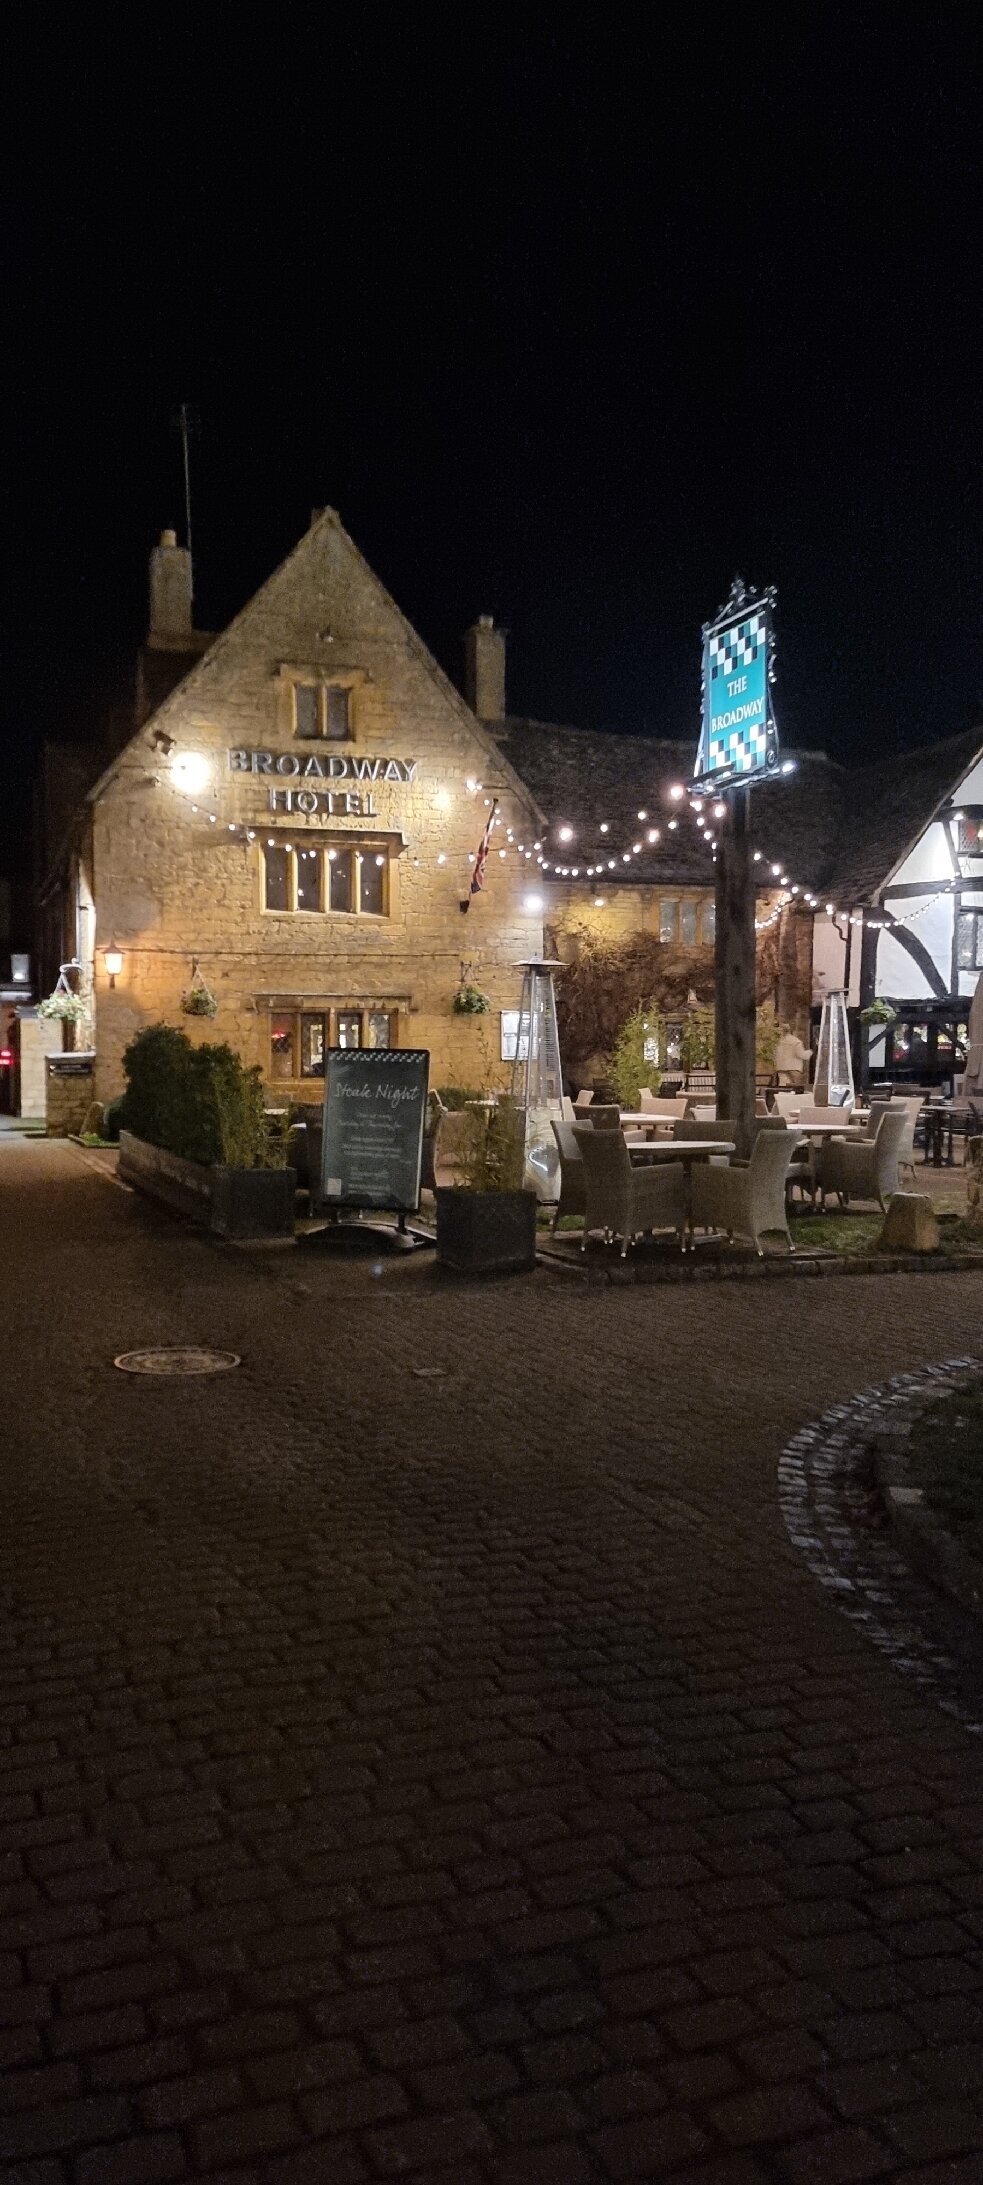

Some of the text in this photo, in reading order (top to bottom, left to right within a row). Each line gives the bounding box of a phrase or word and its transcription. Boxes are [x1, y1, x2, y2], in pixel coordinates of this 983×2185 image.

[727, 676, 747, 697] THE
[712, 697, 763, 732] BROADWAY
[228, 749, 417, 781] BROADWAY
[270, 788, 377, 816] HOTEL
[335, 1083, 419, 1108] Steak Night
